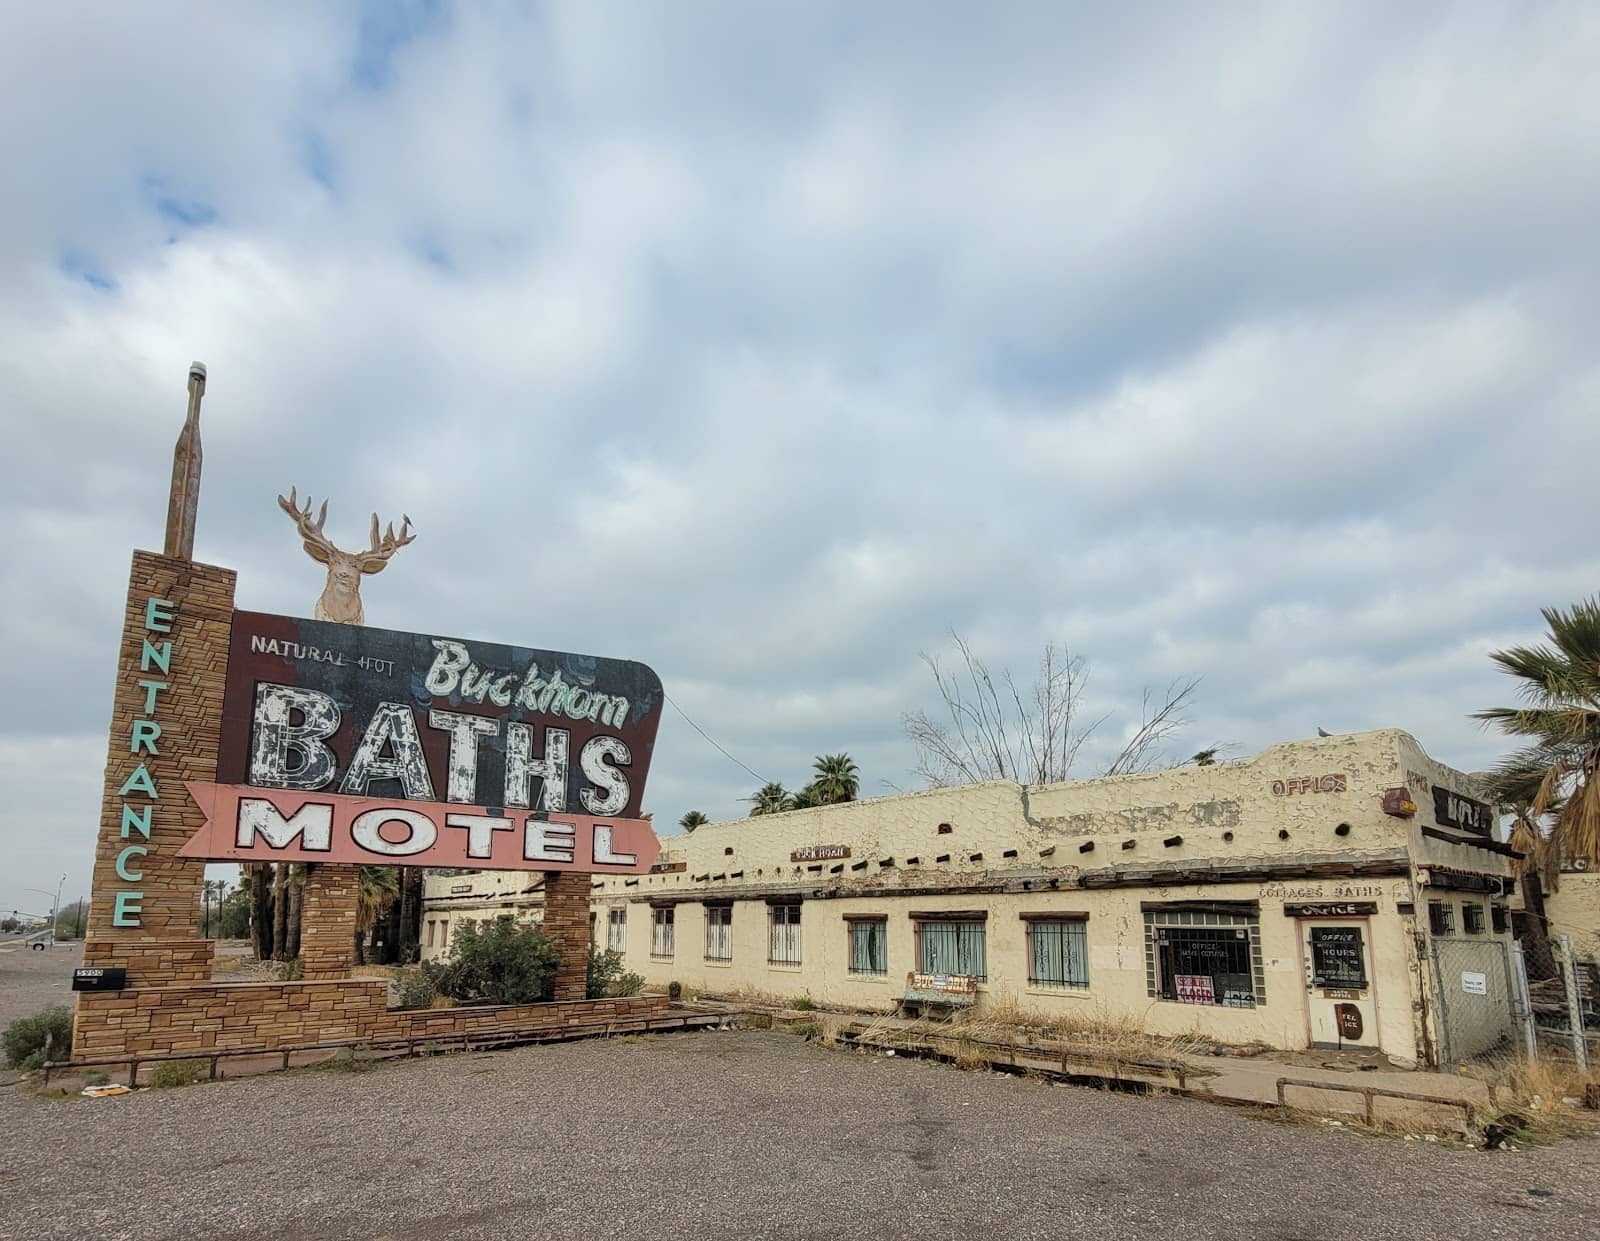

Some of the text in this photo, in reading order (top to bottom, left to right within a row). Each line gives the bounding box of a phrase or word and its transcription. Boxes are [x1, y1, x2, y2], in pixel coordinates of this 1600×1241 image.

[251, 635, 396, 677] NATURAL HOT
[425, 639, 631, 730] Buckhorn
[112, 596, 175, 928] ENTRANCE
[248, 681, 633, 817] BATHS
[235, 797, 638, 866] MOTEL
[1334, 885, 1383, 897] BATHS
